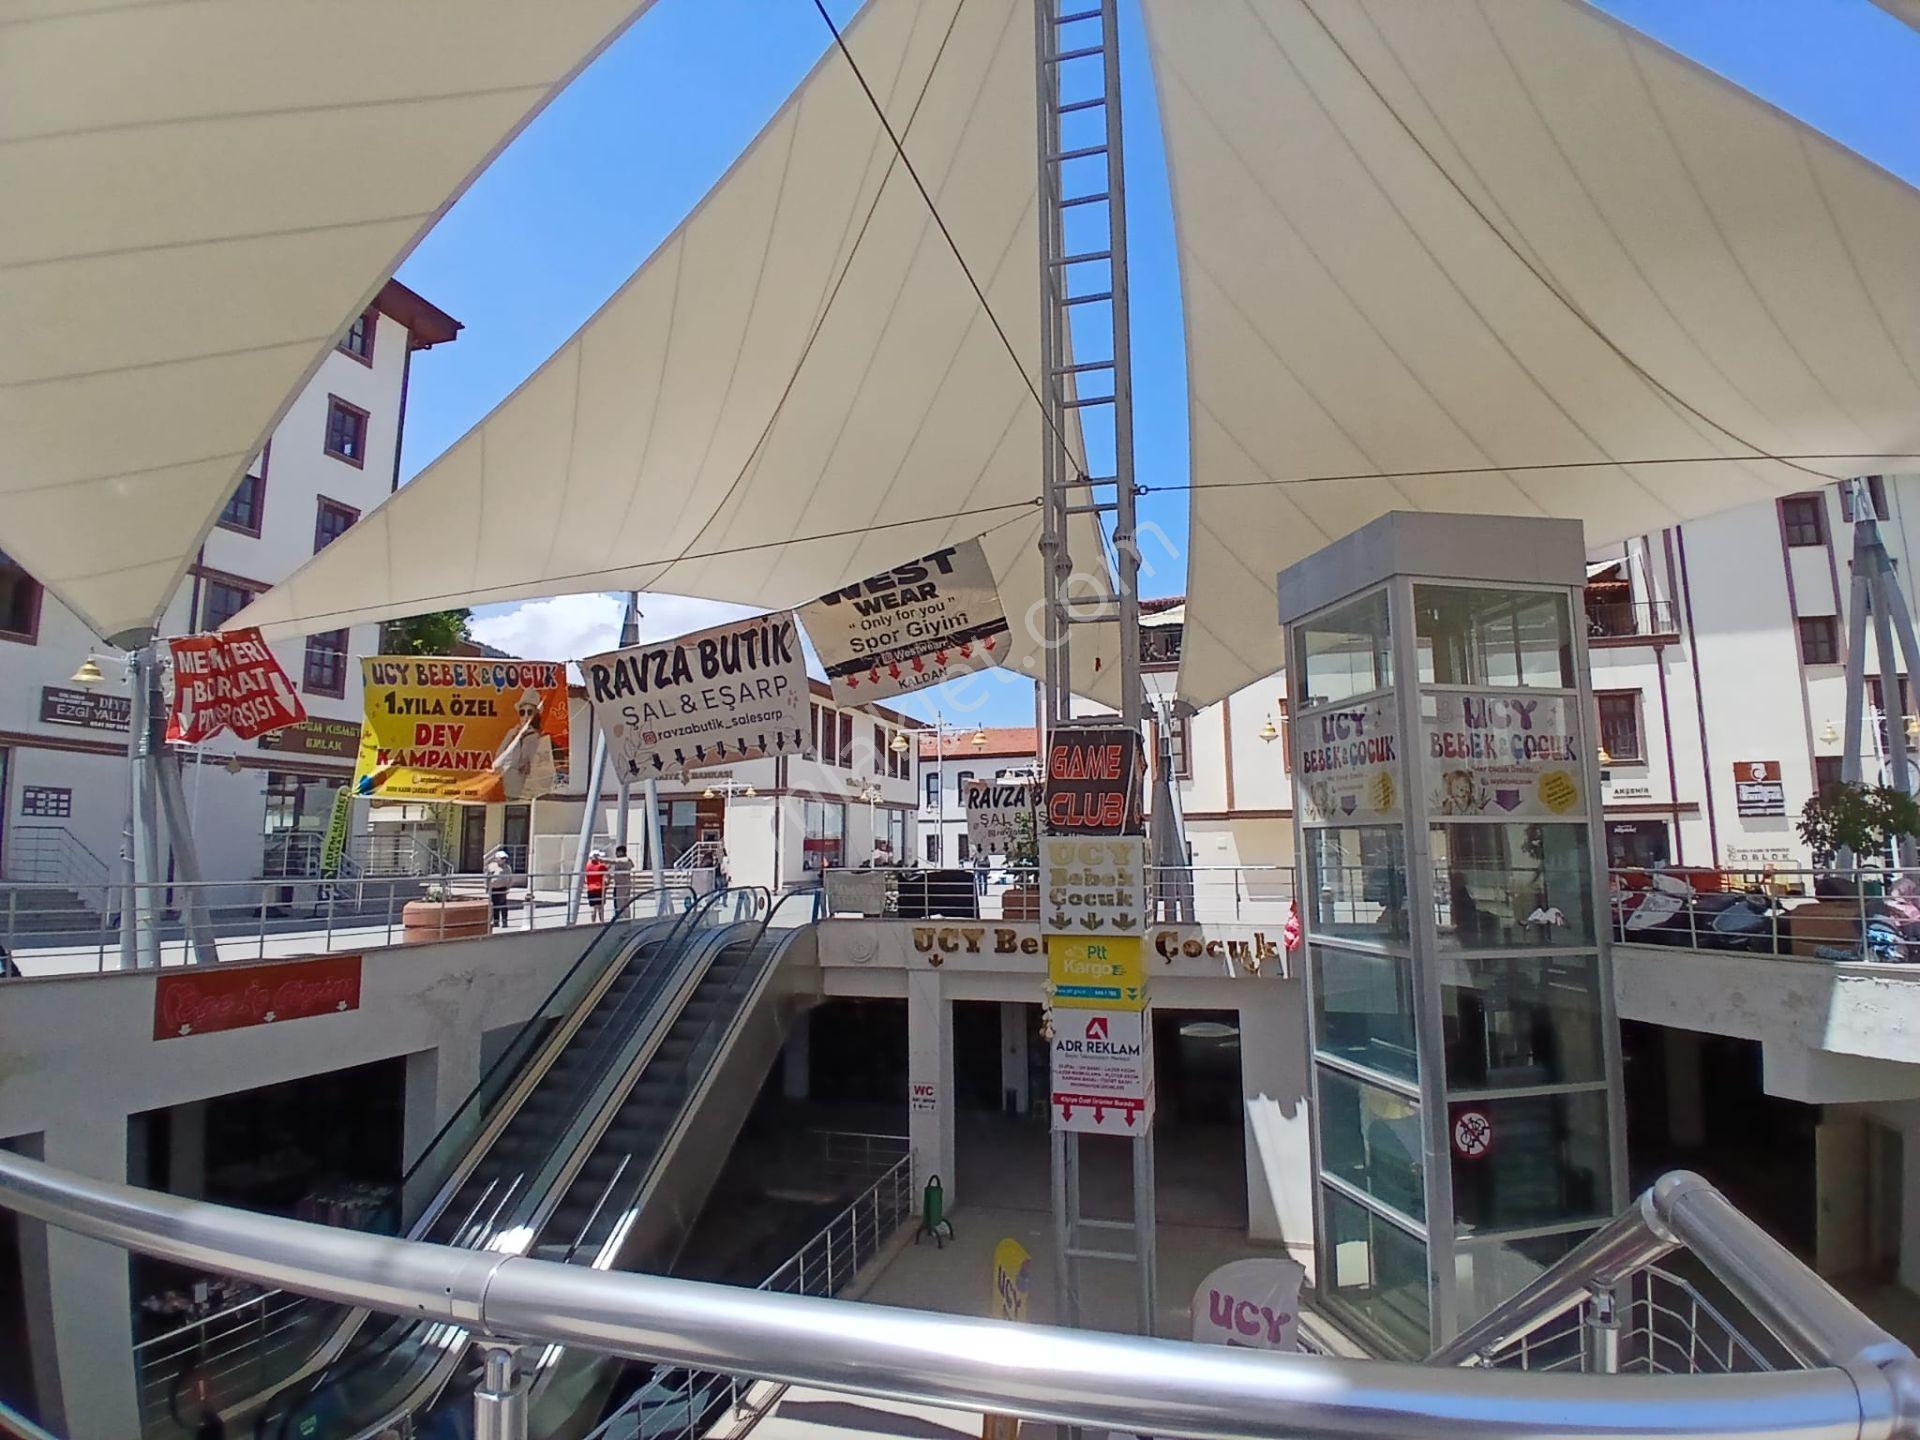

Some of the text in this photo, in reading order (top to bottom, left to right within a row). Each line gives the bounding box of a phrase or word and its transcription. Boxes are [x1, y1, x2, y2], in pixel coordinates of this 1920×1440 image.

[853, 582, 939, 617] WEAR
[861, 602, 945, 631] Only for you
[850, 612, 969, 654] Spor Giyim
[591, 617, 793, 703] RAVZA BUTİK
[371, 663, 410, 686] UCY
[451, 693, 498, 717] ÖZEL
[622, 675, 789, 731] ŞAL & EŞARP
[1463, 697, 1538, 730] UCY
[414, 722, 465, 748] DEV
[657, 709, 783, 741] ravzabutik_salesarp
[1322, 709, 1366, 743] UCY
[305, 738, 342, 751] EMLAK
[375, 749, 495, 771] KAMPANYA
[1050, 745, 1122, 781] GAME
[968, 786, 1026, 809] RAVZA
[1049, 791, 1124, 827] CLUB
[1047, 841, 1137, 867] UCY
[1049, 867, 1135, 888] Bebek
[1049, 888, 1134, 911] Çocuk
[912, 927, 985, 953] UCY
[1087, 945, 1107, 961] Ptt
[1155, 930, 1279, 965] Çocuk
[1063, 959, 1112, 978] Kargo
[1056, 1040, 1140, 1056] ADR REKLAM
[913, 1085, 935, 1096] WC
[1209, 1289, 1291, 1345] UCY
